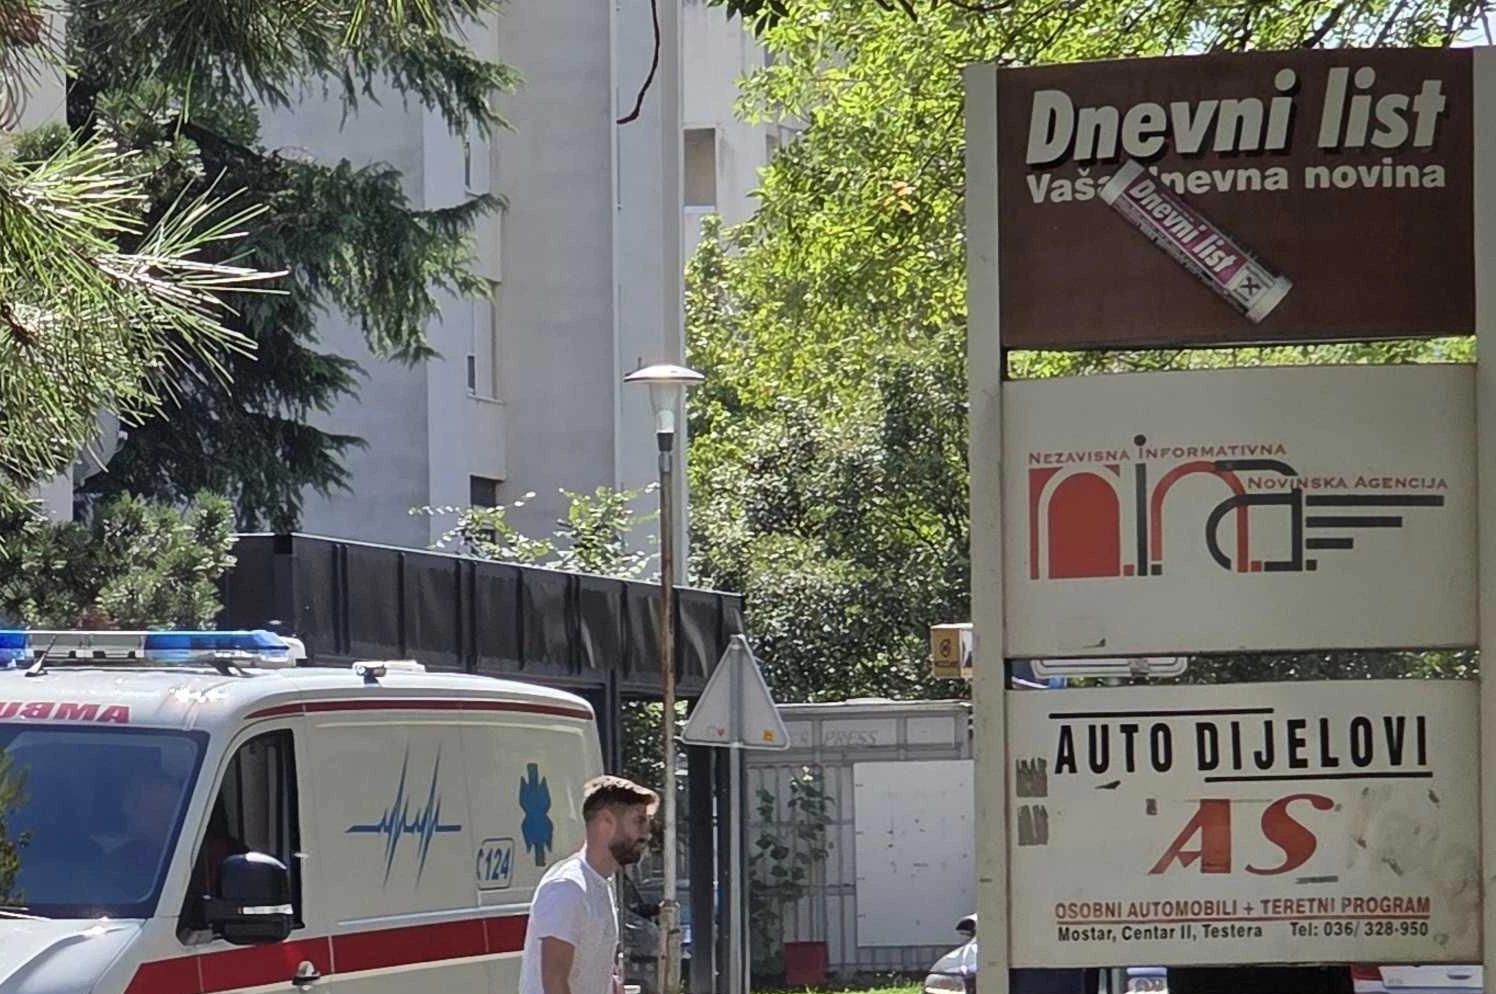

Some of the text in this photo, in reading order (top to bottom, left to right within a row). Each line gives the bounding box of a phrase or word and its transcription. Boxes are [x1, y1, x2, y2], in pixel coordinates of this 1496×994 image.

[1025, 66, 1447, 166] Dnevni list
[1026, 157, 1446, 204] Vaš nevna novina
[1128, 178, 1238, 273] Dnevni list
[1028, 442, 1288, 465] NEZAVISNA INFORMATIVNA
[1247, 473, 1449, 491] NOVINSKA AGENCIJA
[1054, 715, 1428, 775] AUTO DIJELOVI
[1147, 793, 1335, 876] AS
[484, 847, 512, 881] 124
[1055, 901, 1123, 920] OSOBNI
[1126, 898, 1238, 918] AUTOMOBILI
[1260, 897, 1337, 916] TERETNI
[1340, 895, 1431, 914] PROGRAM
[1057, 925, 1117, 943] Mostar,
[1121, 924, 1176, 941] Centar
[1200, 922, 1263, 939] Testera
[1290, 921, 1319, 937] Tel:
[1322, 921, 1358, 938] 036/
